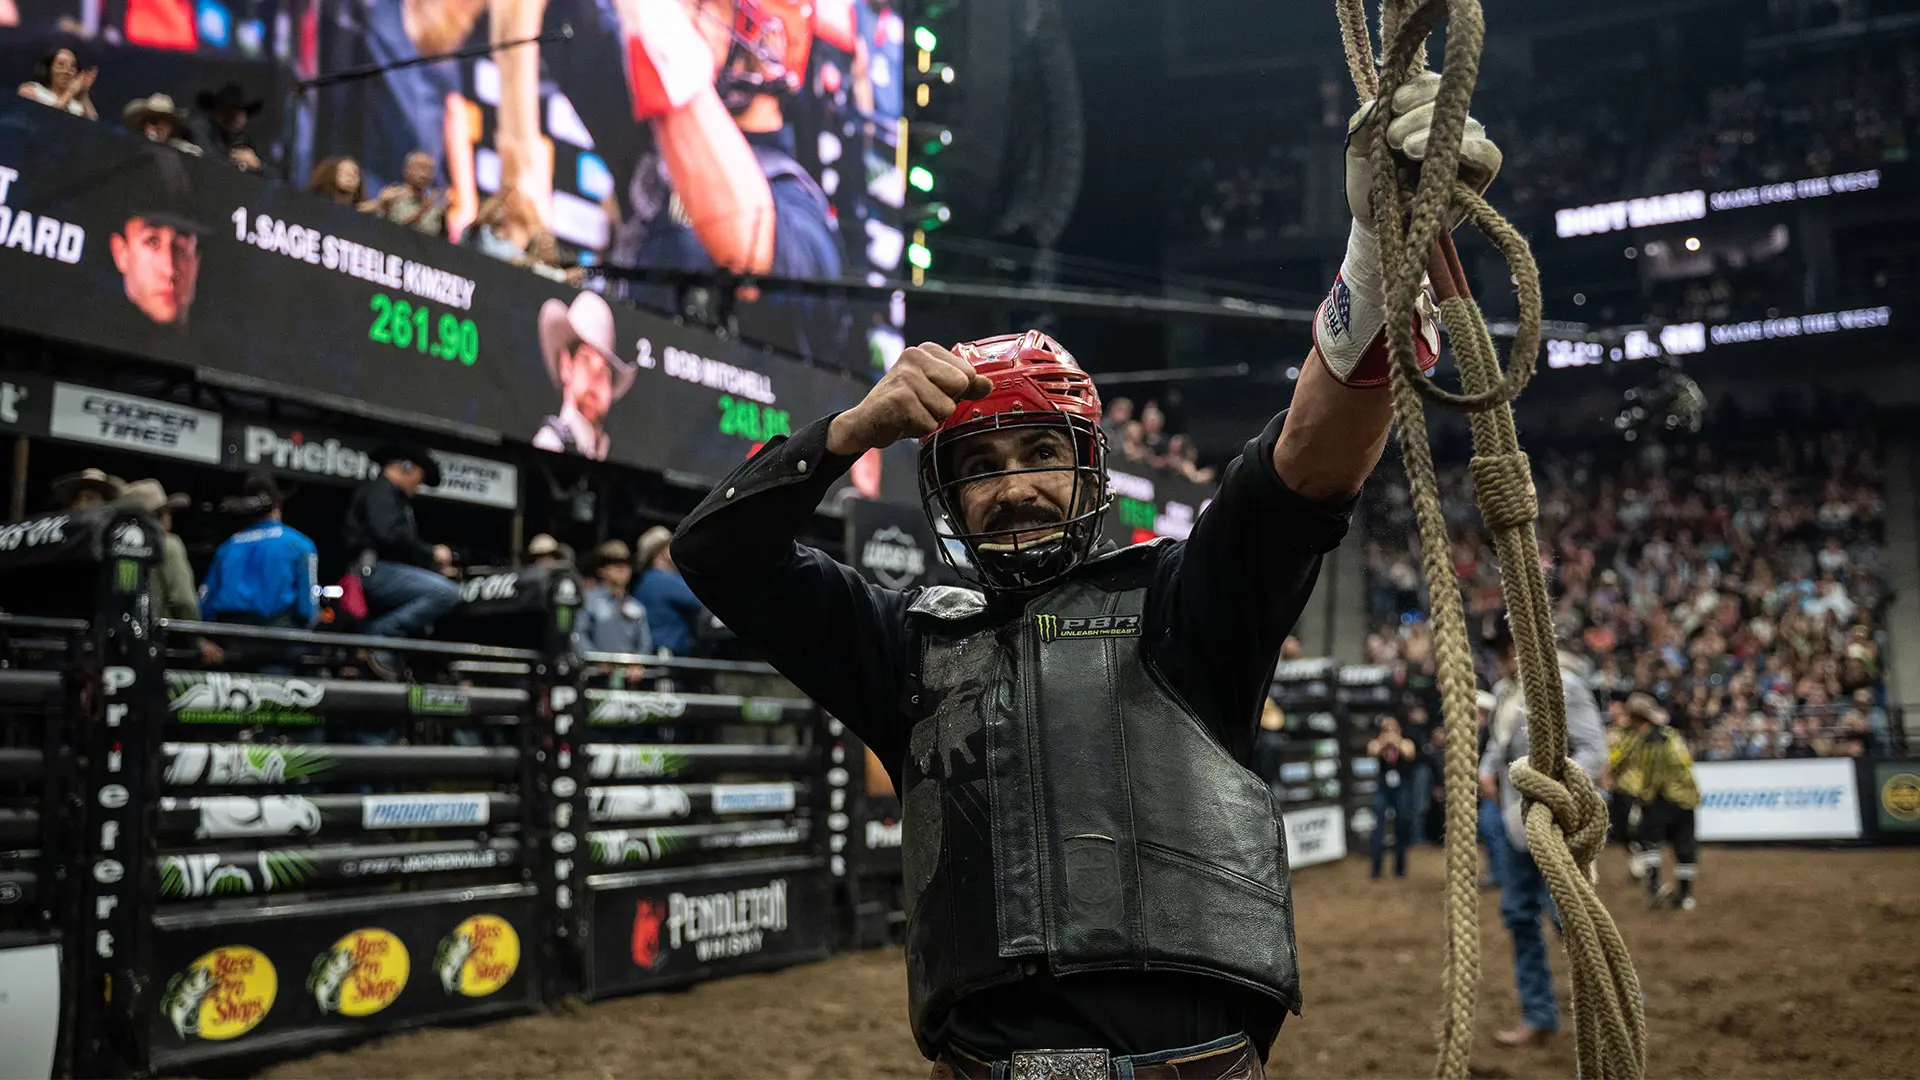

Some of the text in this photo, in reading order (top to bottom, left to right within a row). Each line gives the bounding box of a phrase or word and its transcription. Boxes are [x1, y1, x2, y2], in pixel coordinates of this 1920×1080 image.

[321, 235, 403, 289] STEELE
[369, 293, 479, 366] 261.90
[82, 395, 199, 433] COOPER
[100, 418, 180, 448] TIRES
[244, 425, 382, 481] Priefer
[1061, 628, 1098, 637] UNLEASH
[1110, 627, 1137, 635] BEAST
[1700, 785, 1846, 809] ROGRESSIVE
[666, 878, 787, 949] PENDLETON
[696, 929, 764, 962] WHISKY
